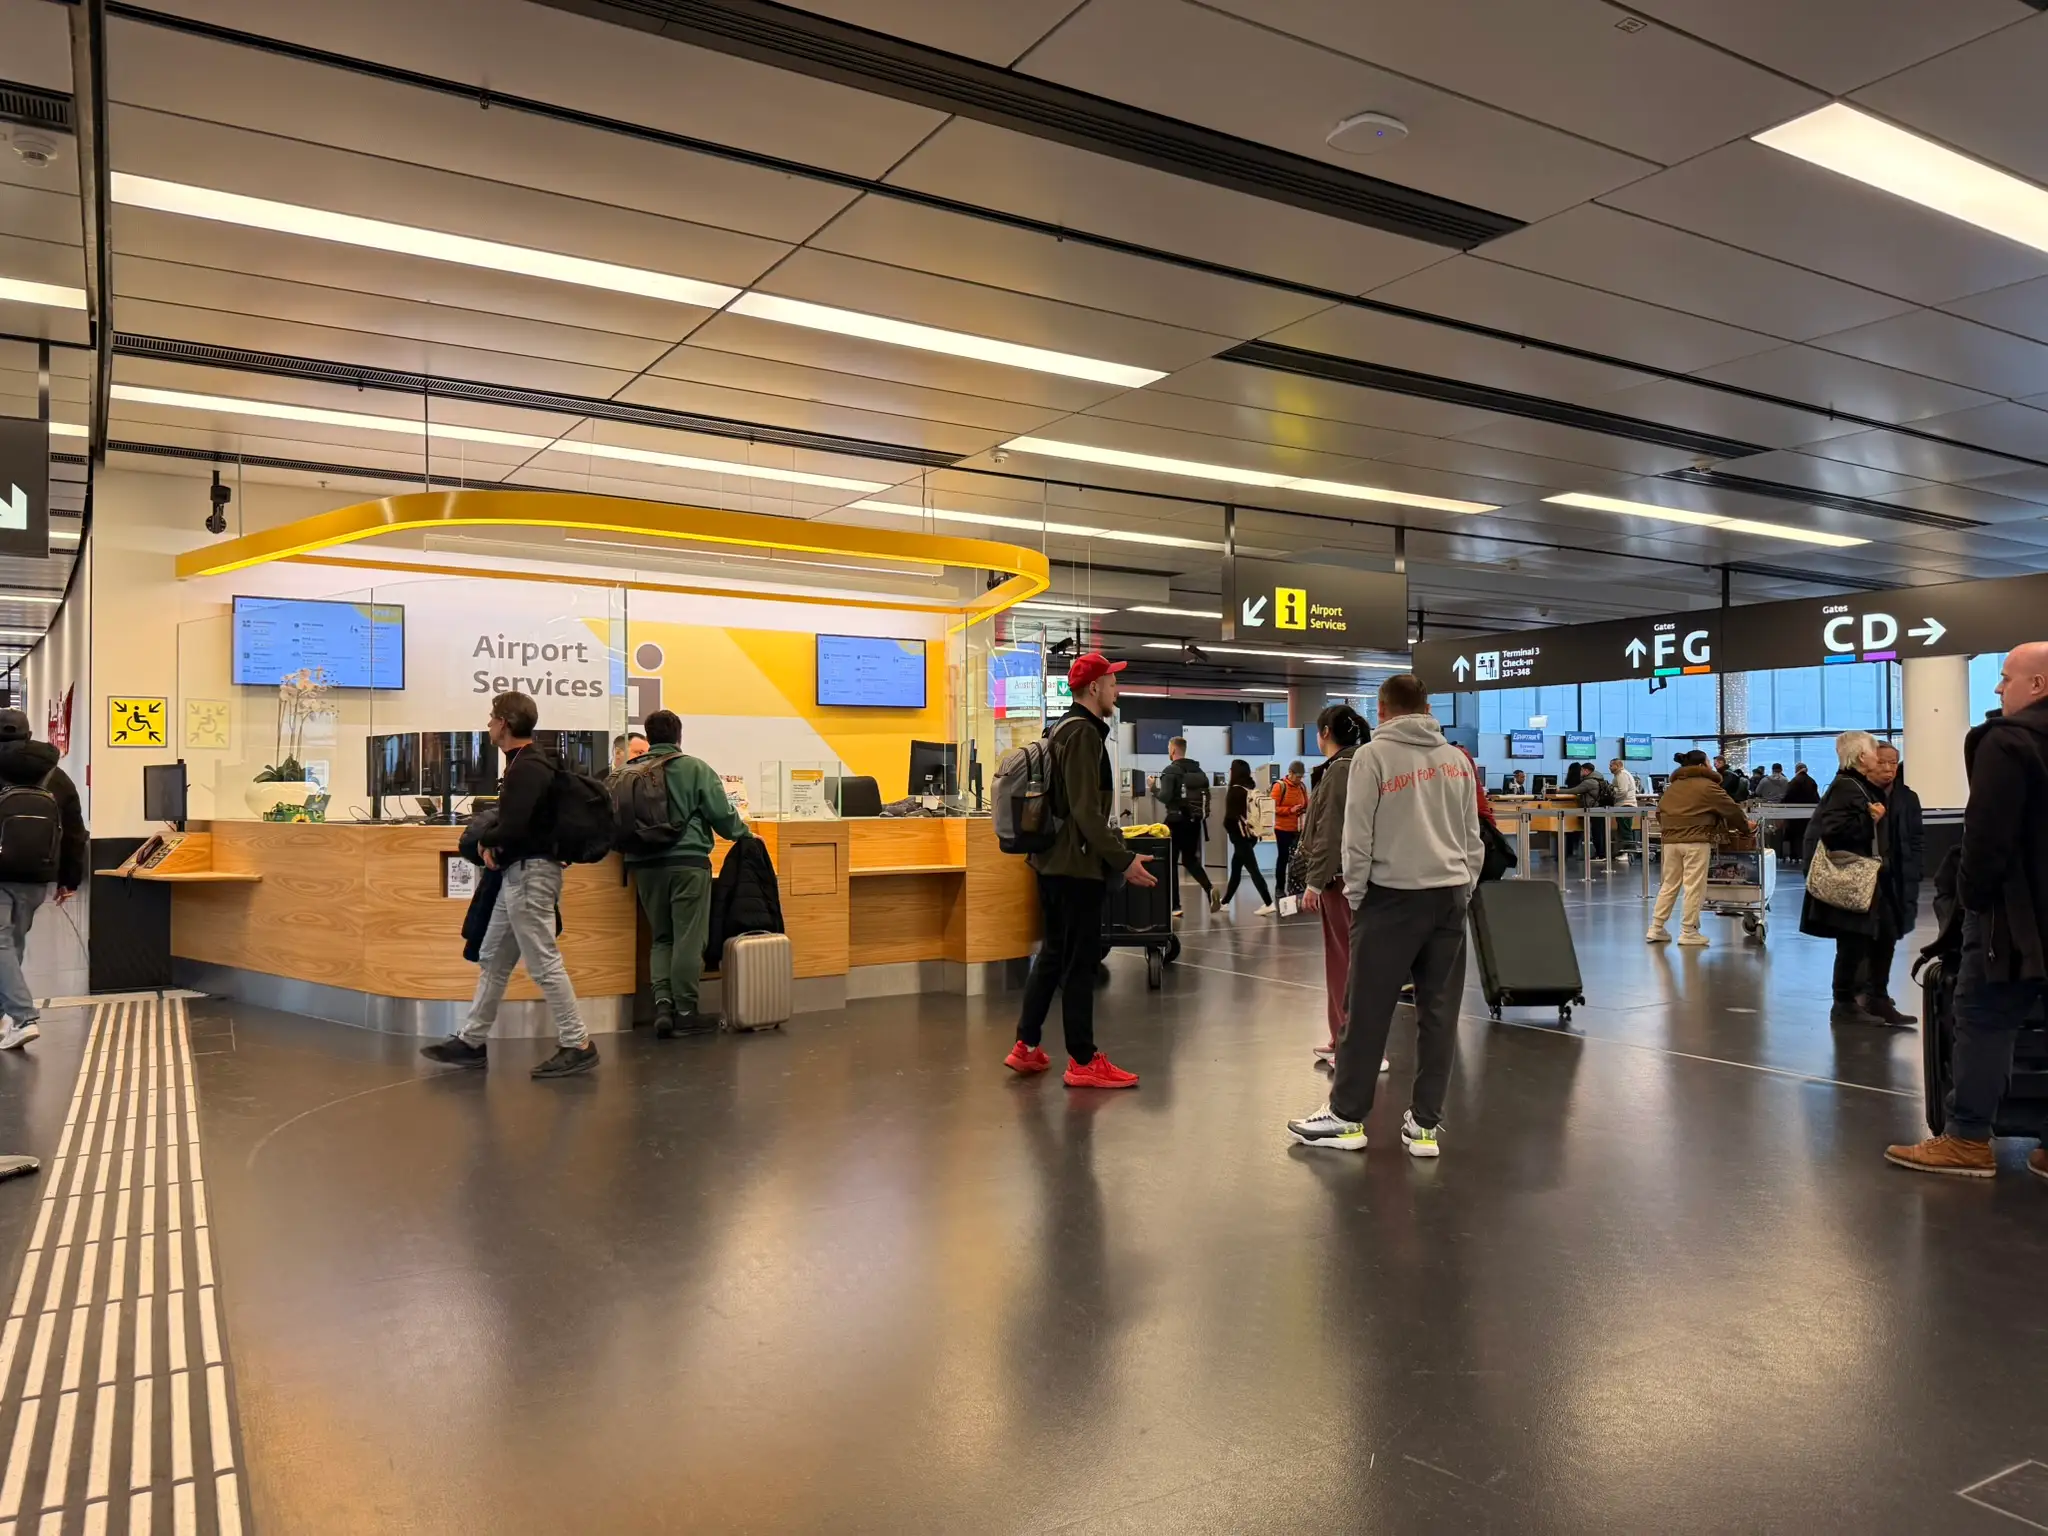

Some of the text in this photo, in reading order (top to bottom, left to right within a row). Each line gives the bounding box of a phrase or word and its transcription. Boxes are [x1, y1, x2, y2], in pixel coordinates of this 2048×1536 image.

[1310, 604, 1342, 617] Airport
[1822, 605, 1848, 614] Gates
[1310, 619, 1347, 631] Services
[1654, 623, 1676, 631] Gates
[472, 633, 589, 666] Airport
[1502, 647, 1540, 658] Terminal 3
[1502, 658, 1534, 667] Check-in
[472, 670, 604, 698] Services
[1381, 772, 1416, 796] READY
[1417, 768, 1436, 781] FOR
